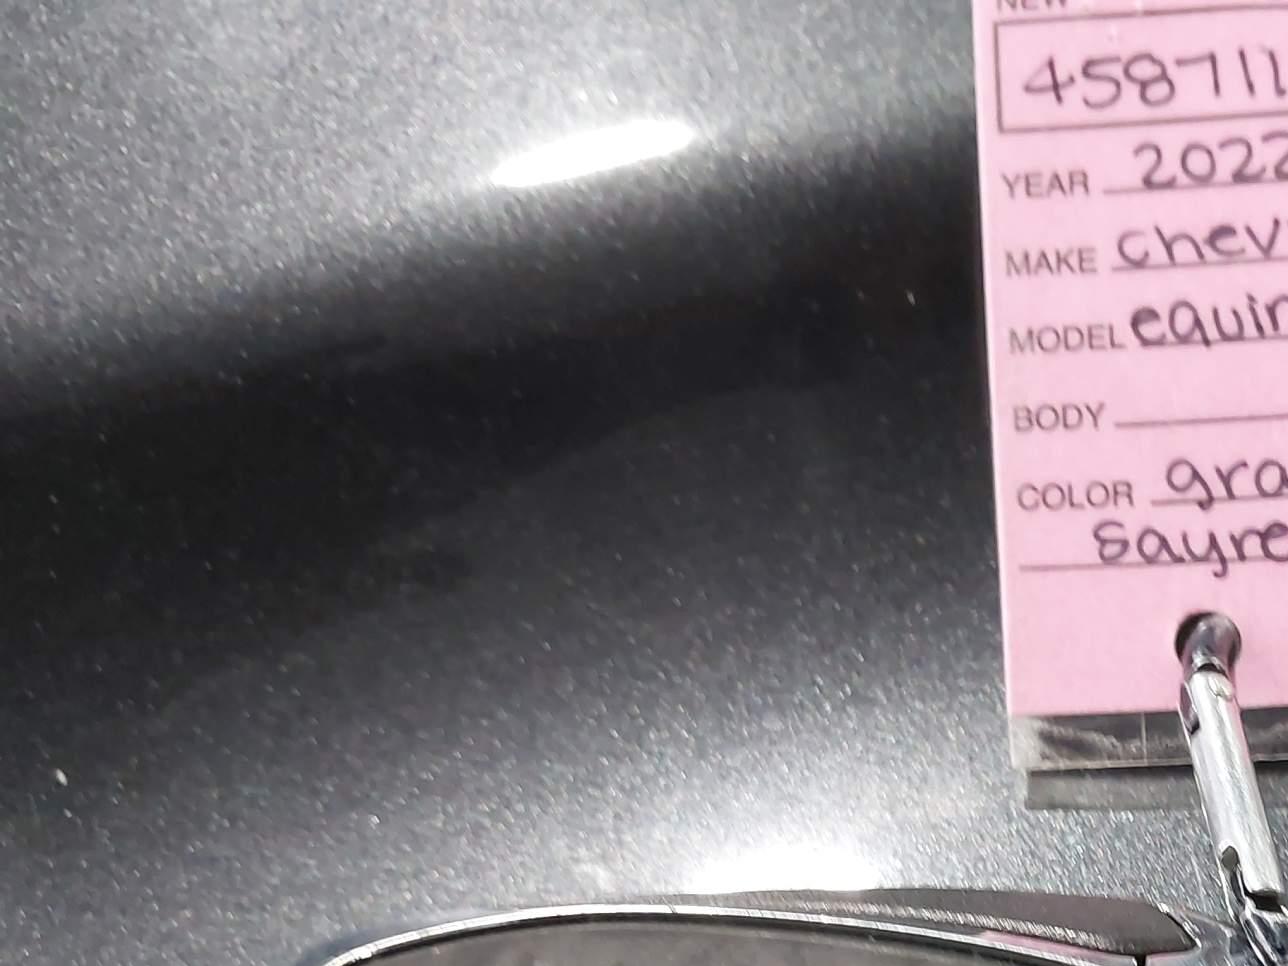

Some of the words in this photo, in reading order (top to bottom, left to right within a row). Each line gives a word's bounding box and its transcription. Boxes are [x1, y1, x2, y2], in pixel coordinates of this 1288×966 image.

[1023, 47, 1287, 109] 458711
[1001, 170, 1090, 198] YEAR
[1005, 247, 1099, 277] MAKE
[1009, 324, 1126, 354] MODEL
[1013, 402, 1106, 431] BODY
[1017, 480, 1135, 510] COLOR
